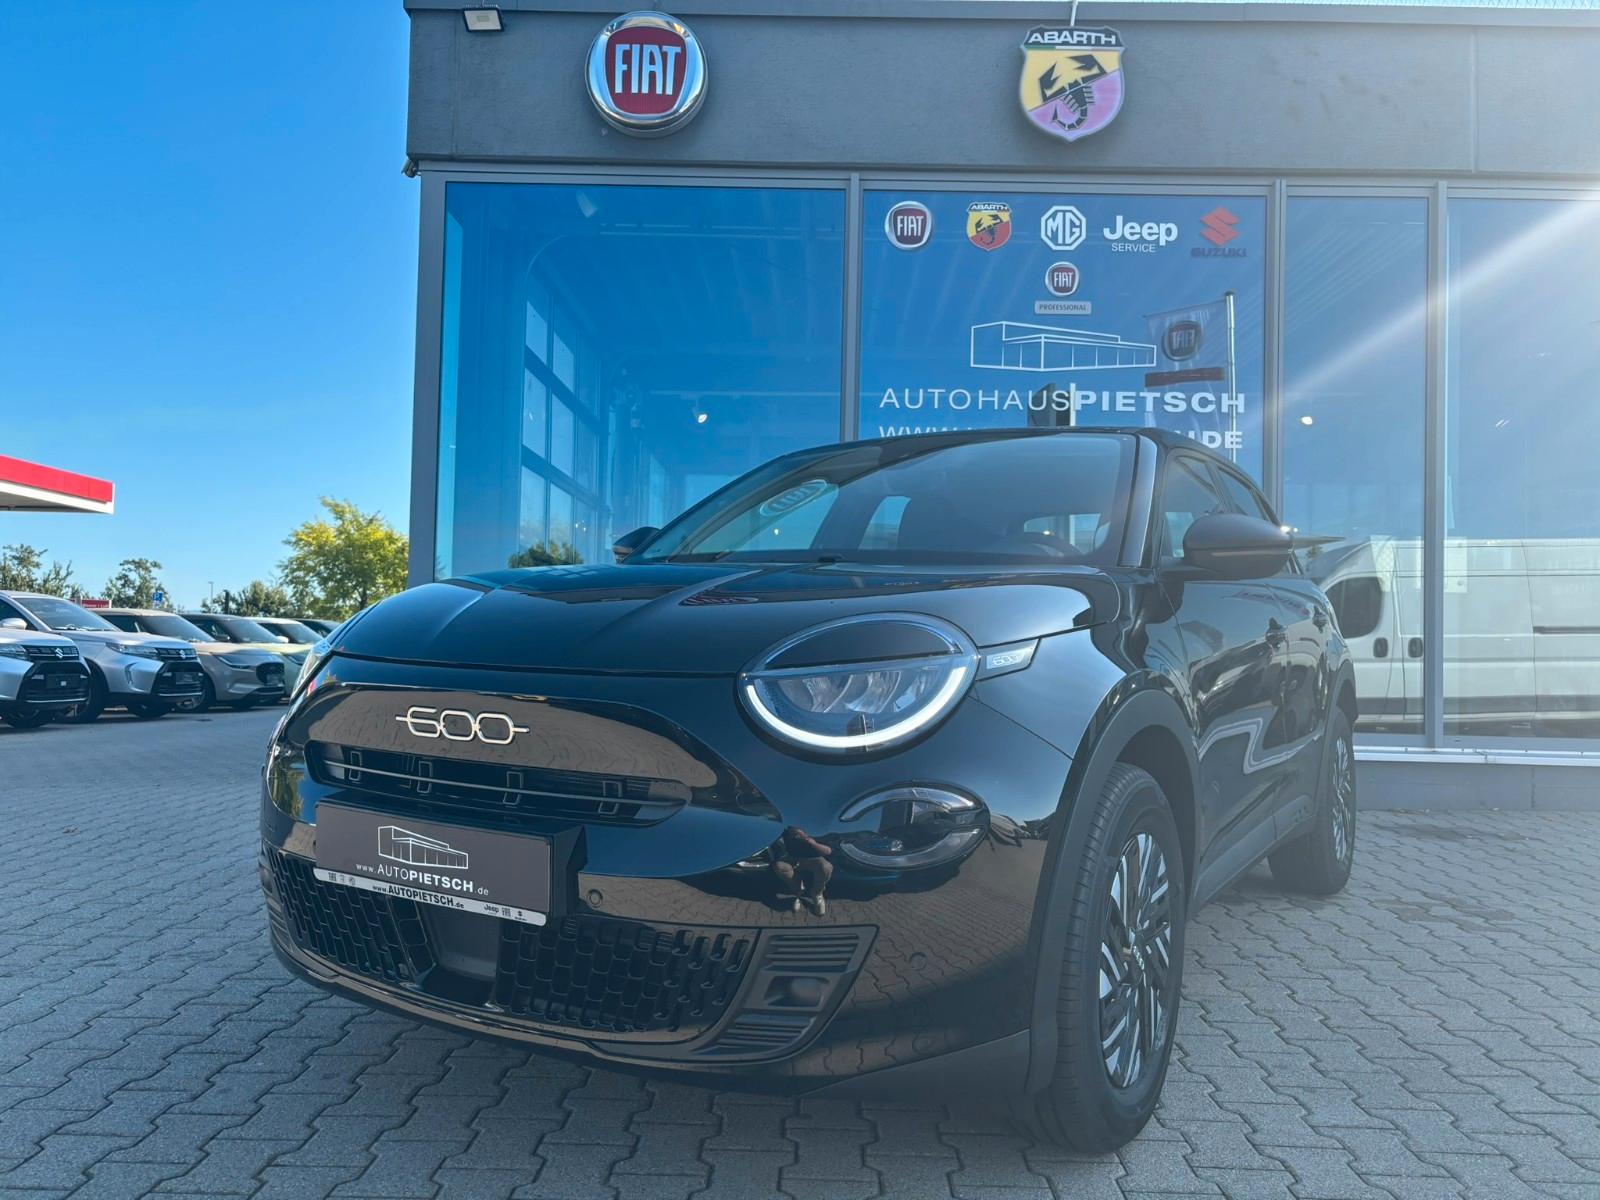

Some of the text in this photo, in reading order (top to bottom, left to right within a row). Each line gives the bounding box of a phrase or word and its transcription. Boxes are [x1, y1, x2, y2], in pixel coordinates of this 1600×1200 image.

[1028, 31, 1116, 45] ABARTH
[615, 44, 682, 95] FIAT
[970, 203, 1008, 211] ABARTH
[896, 215, 924, 237] FIAT
[1046, 211, 1081, 245] MG
[1103, 215, 1178, 246] Jeep
[1111, 242, 1156, 253] SERVICE
[1191, 248, 1247, 258] SUZUKI
[1053, 272, 1075, 288] FIAT
[1038, 303, 1087, 312] PROFESSIONAL
[407, 706, 514, 745] 600
[355, 863, 489, 896] www.AUTOPIETSCH.de
[372, 885, 465, 909] www.AUTOPIETSCH.de
